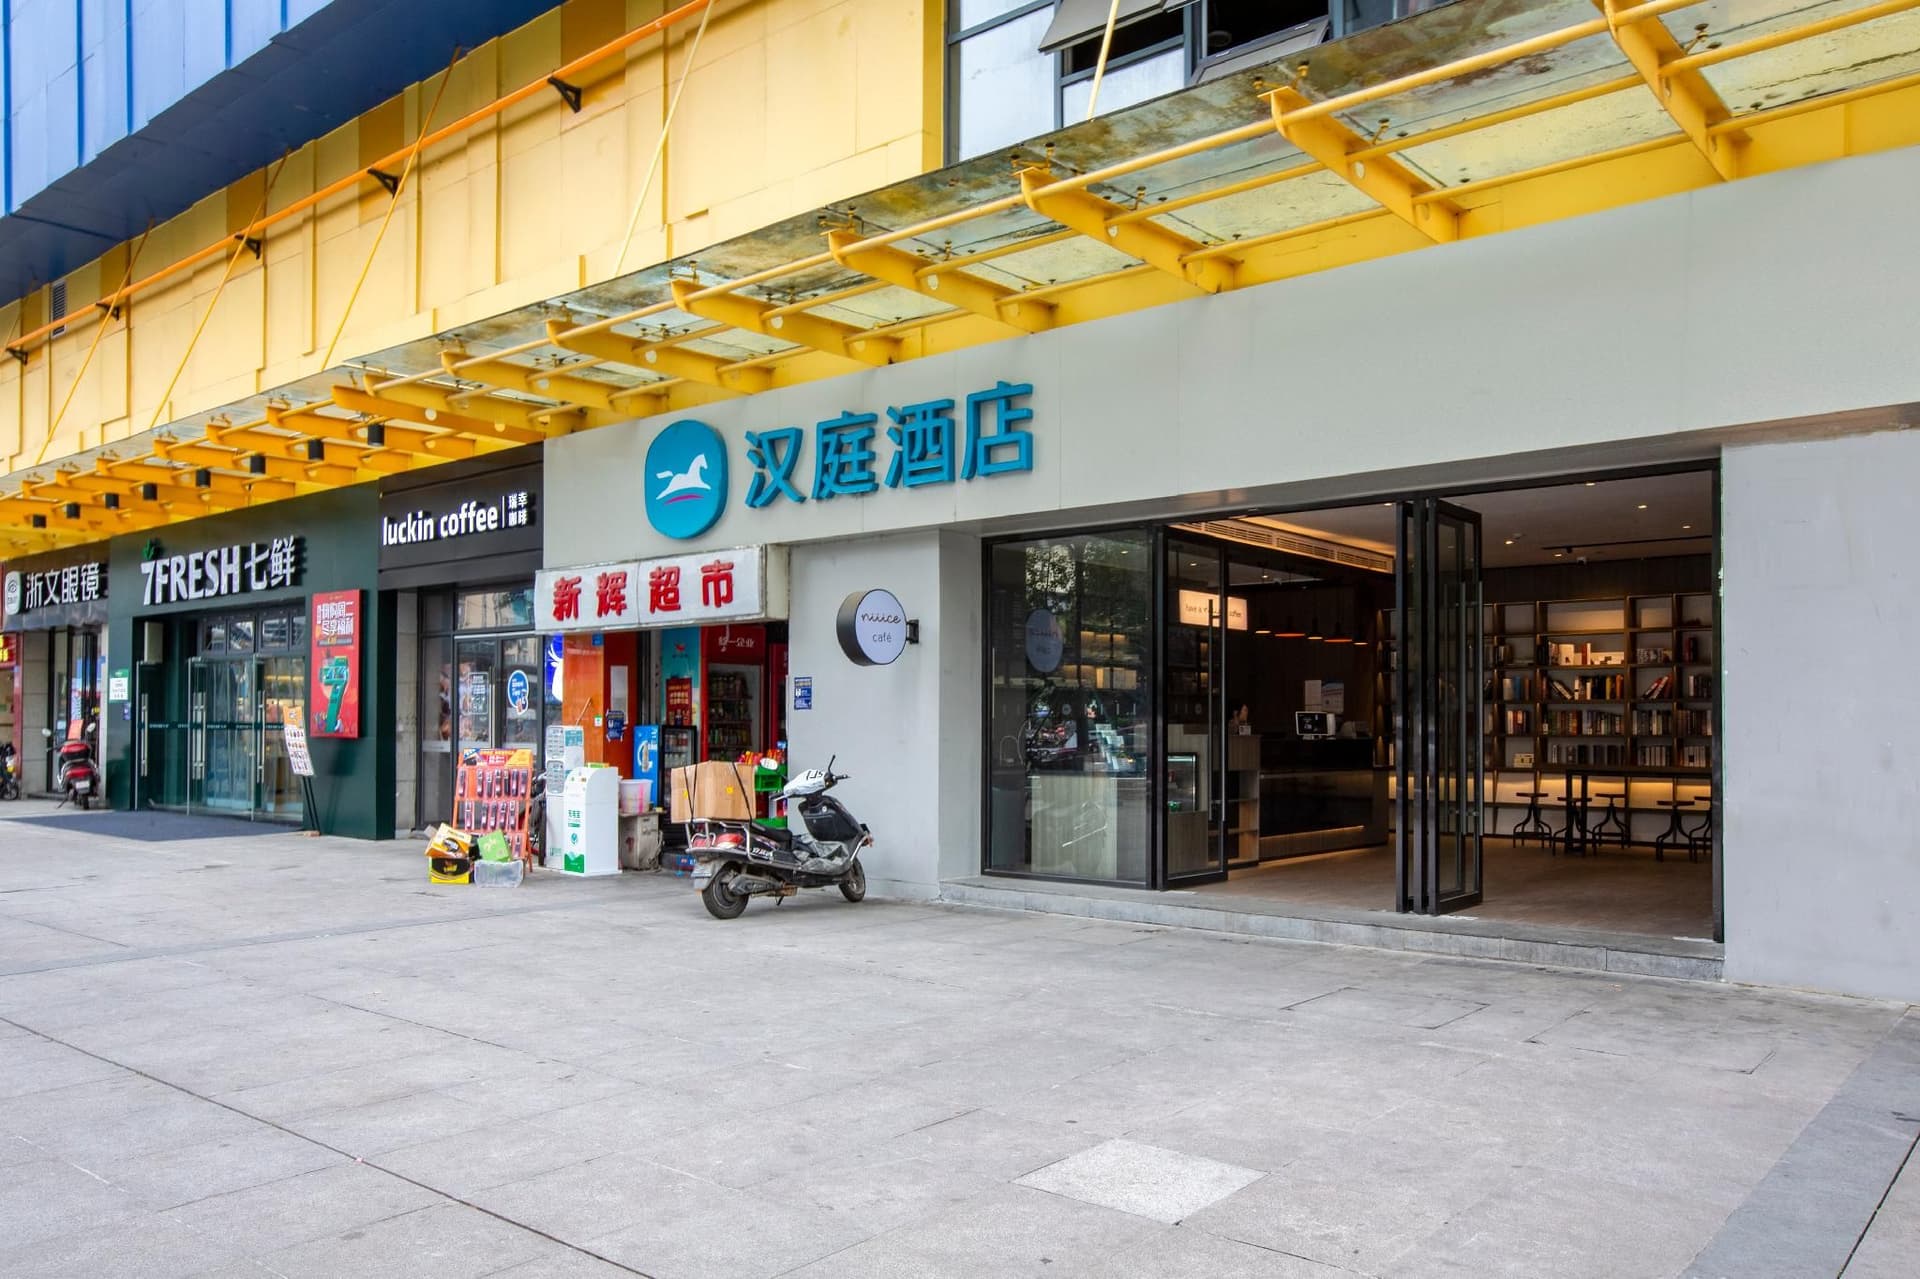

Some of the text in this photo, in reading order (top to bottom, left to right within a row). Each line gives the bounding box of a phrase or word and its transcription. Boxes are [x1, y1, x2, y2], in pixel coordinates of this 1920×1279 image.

[744, 380, 1034, 508] 汉庭酒店
[383, 500, 498, 546] luckin coffee
[508, 491, 528, 509] 瑞幸
[508, 509, 528, 527] 咖啡
[26, 562, 100, 609] 浙文眼镜
[140, 535, 296, 606] 7FRESH 七鲜
[552, 559, 735, 622] 新辉超市
[861, 612, 902, 624] niiice
[872, 632, 893, 643] café
